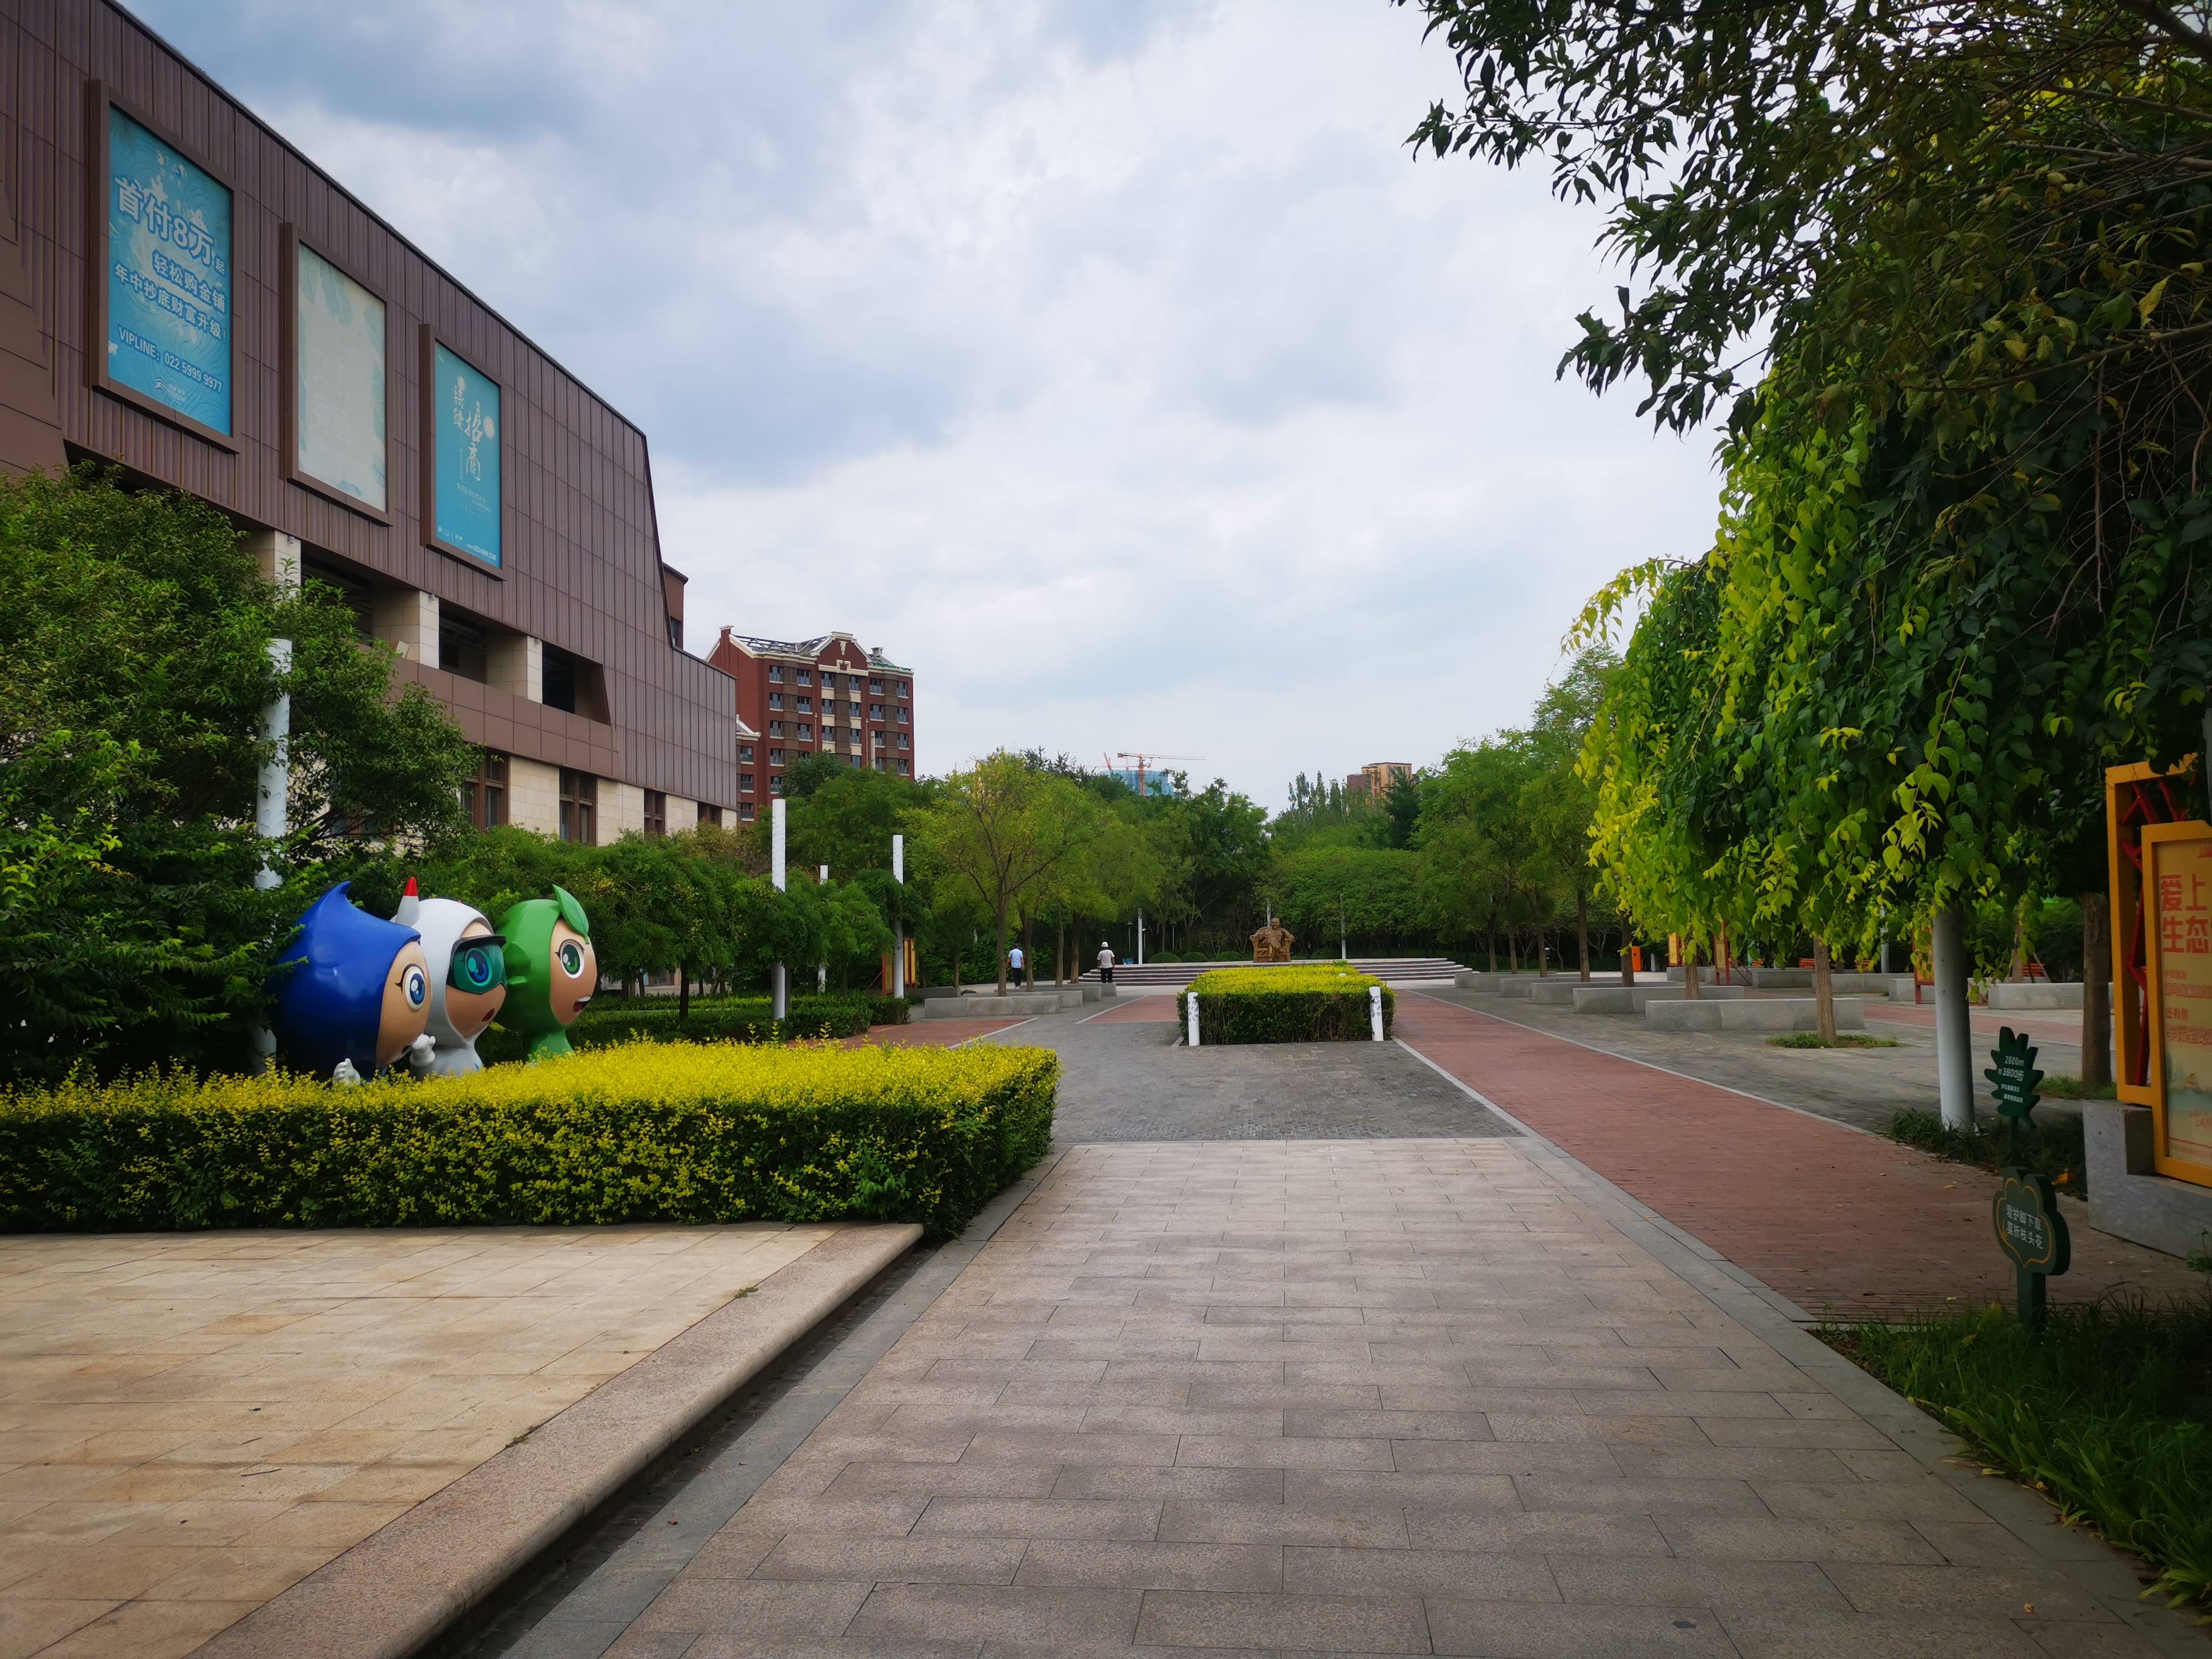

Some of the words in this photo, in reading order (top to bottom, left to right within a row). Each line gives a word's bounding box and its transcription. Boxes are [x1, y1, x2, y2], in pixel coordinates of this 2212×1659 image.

[154, 253, 225, 312] 轻松购金铺
[165, 352, 180, 370] 022
[182, 362, 201, 382] 5999
[204, 374, 222, 392] 9977
[464, 400, 484, 474] 招商
[2160, 873, 2208, 911] 爱上
[2005, 1055, 2025, 1067] 2600m
[2006, 1204, 2042, 1232] 爱护脚下草
[2006, 1221, 2043, 1250] 莫折枝头花
